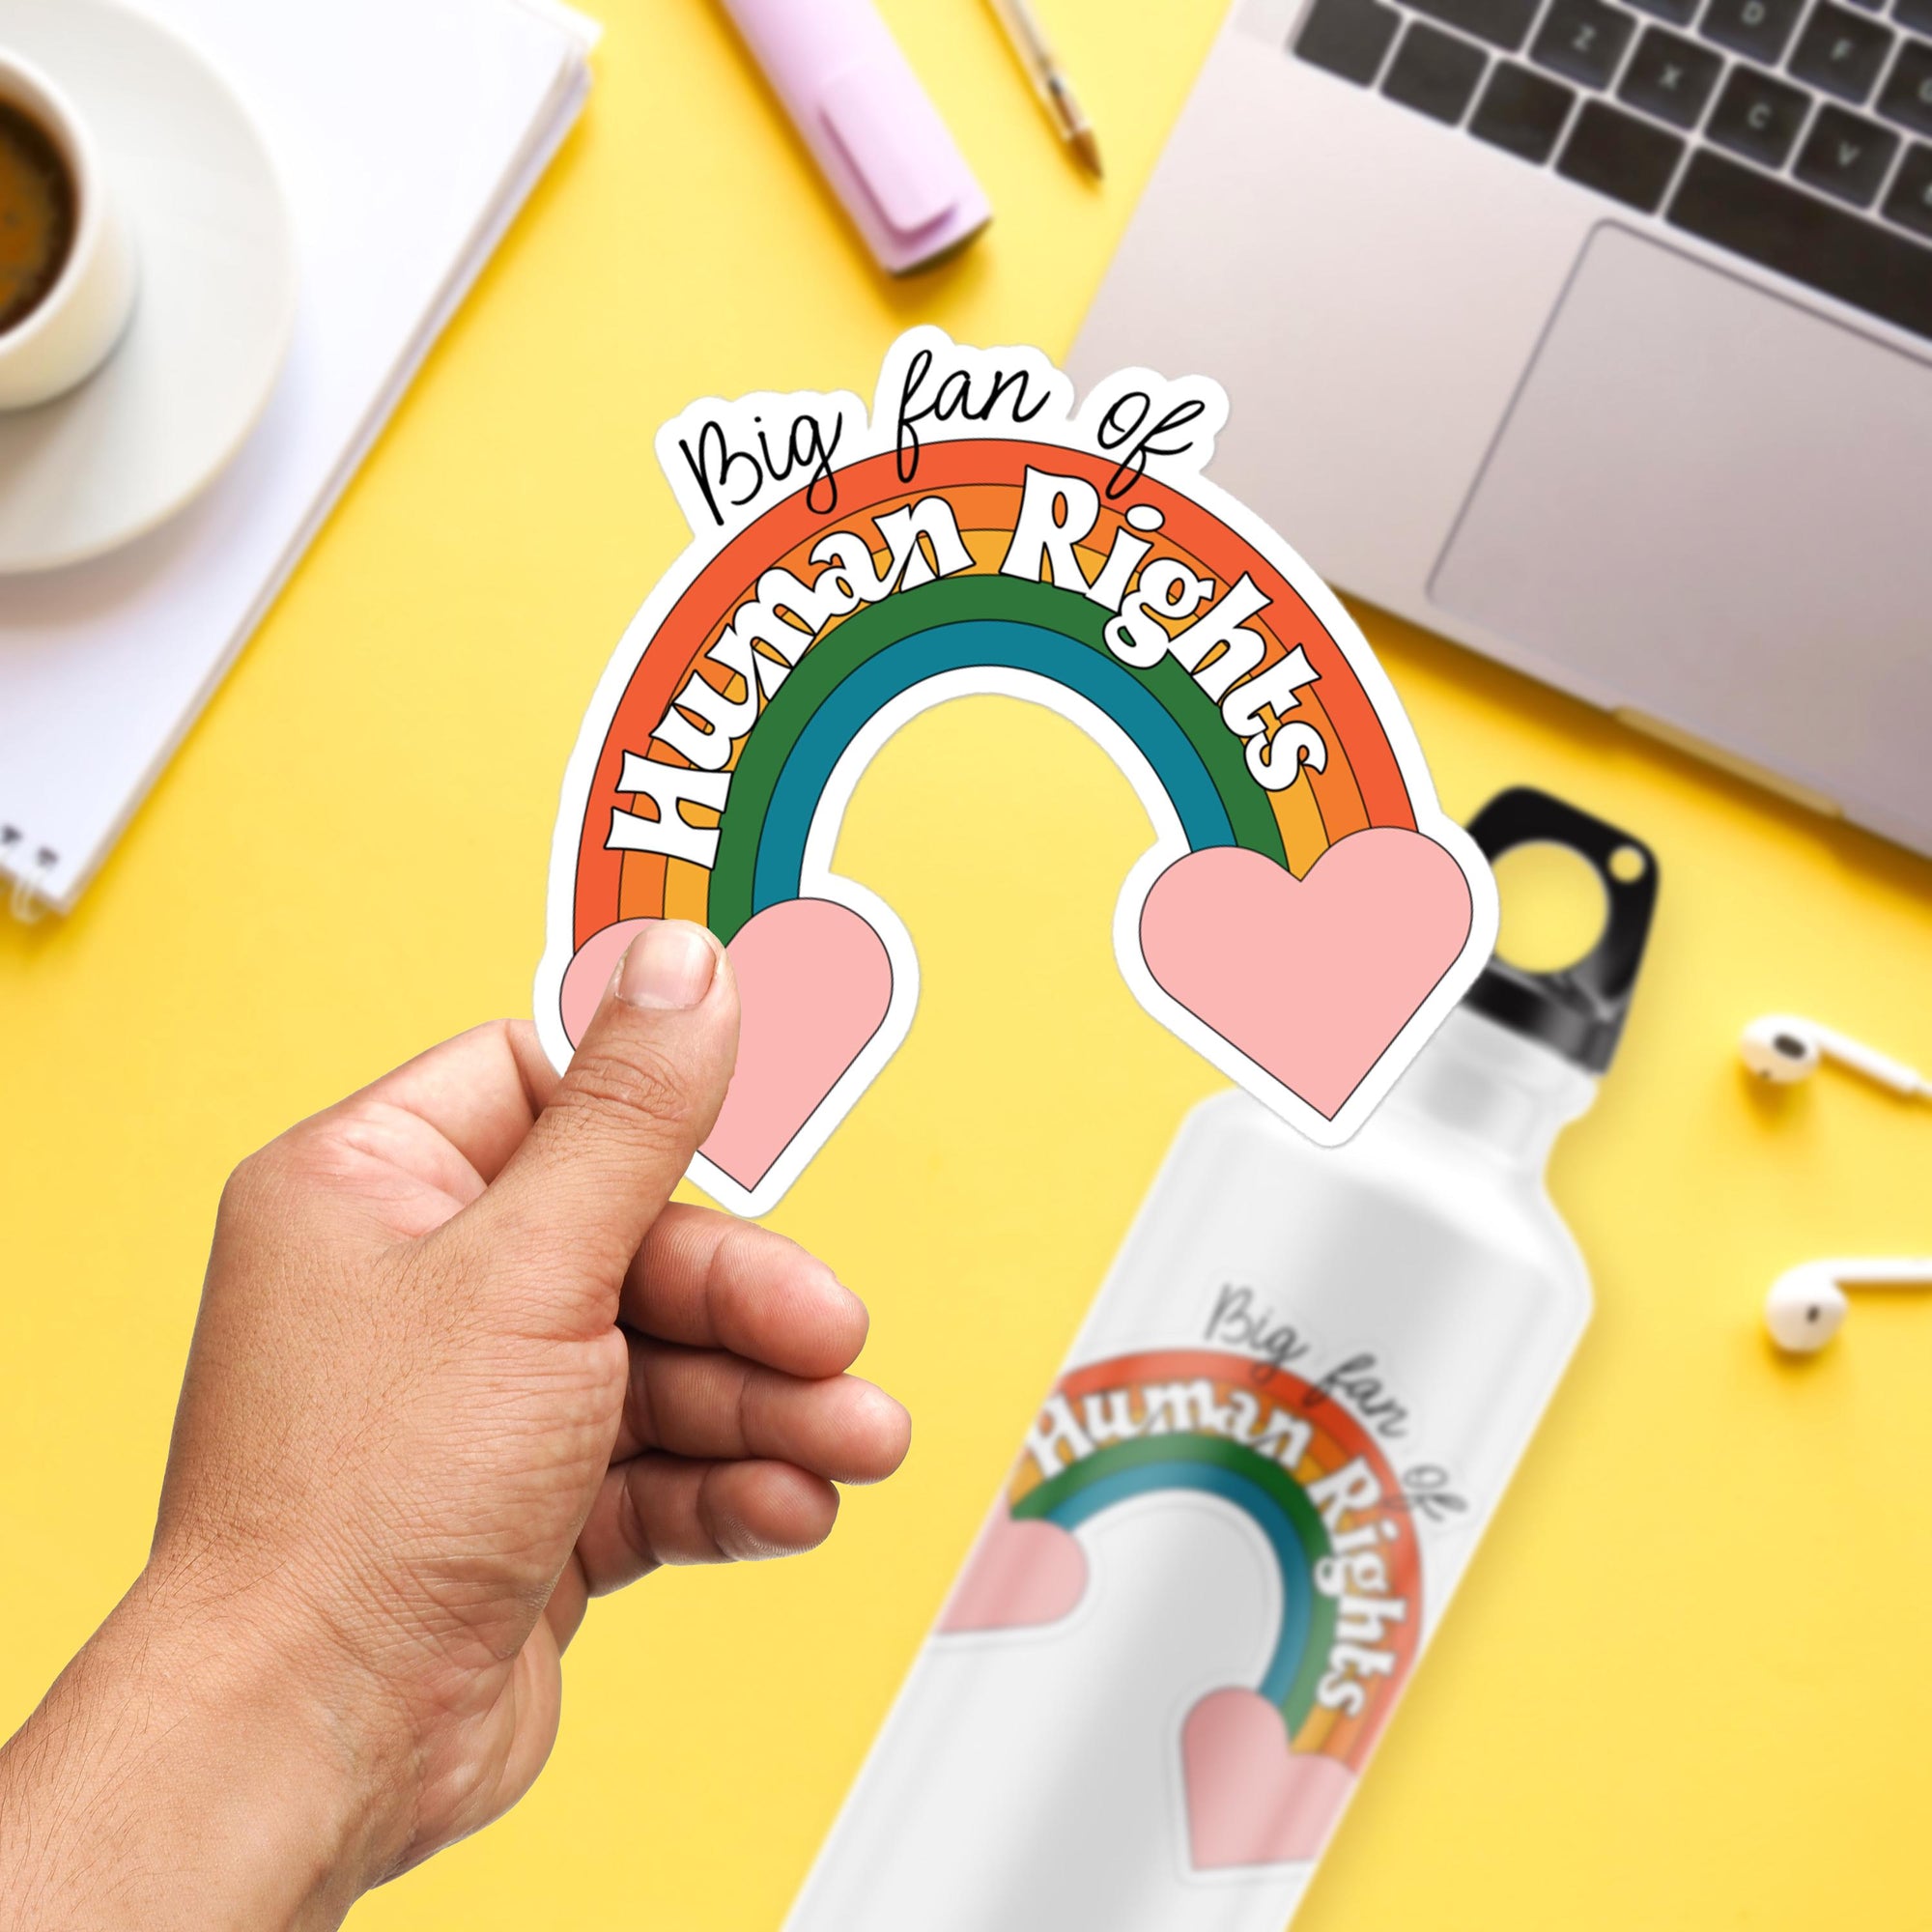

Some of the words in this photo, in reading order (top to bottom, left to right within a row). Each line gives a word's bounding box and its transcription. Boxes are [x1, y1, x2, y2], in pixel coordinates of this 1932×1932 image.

[1658, 62, 1682, 91] X
[1747, 101, 1772, 128] C
[1838, 142, 1861, 166] V
[678, 411, 842, 526] Big
[898, 349, 1050, 482] fan
[604, 495, 976, 870] Human
[999, 465, 1327, 791] Rights
[1204, 1283, 1309, 1383] Big
[1302, 1353, 1407, 1439] fan
[1026, 1378, 1314, 1480] Human
[1306, 1454, 1406, 1716] Rights
